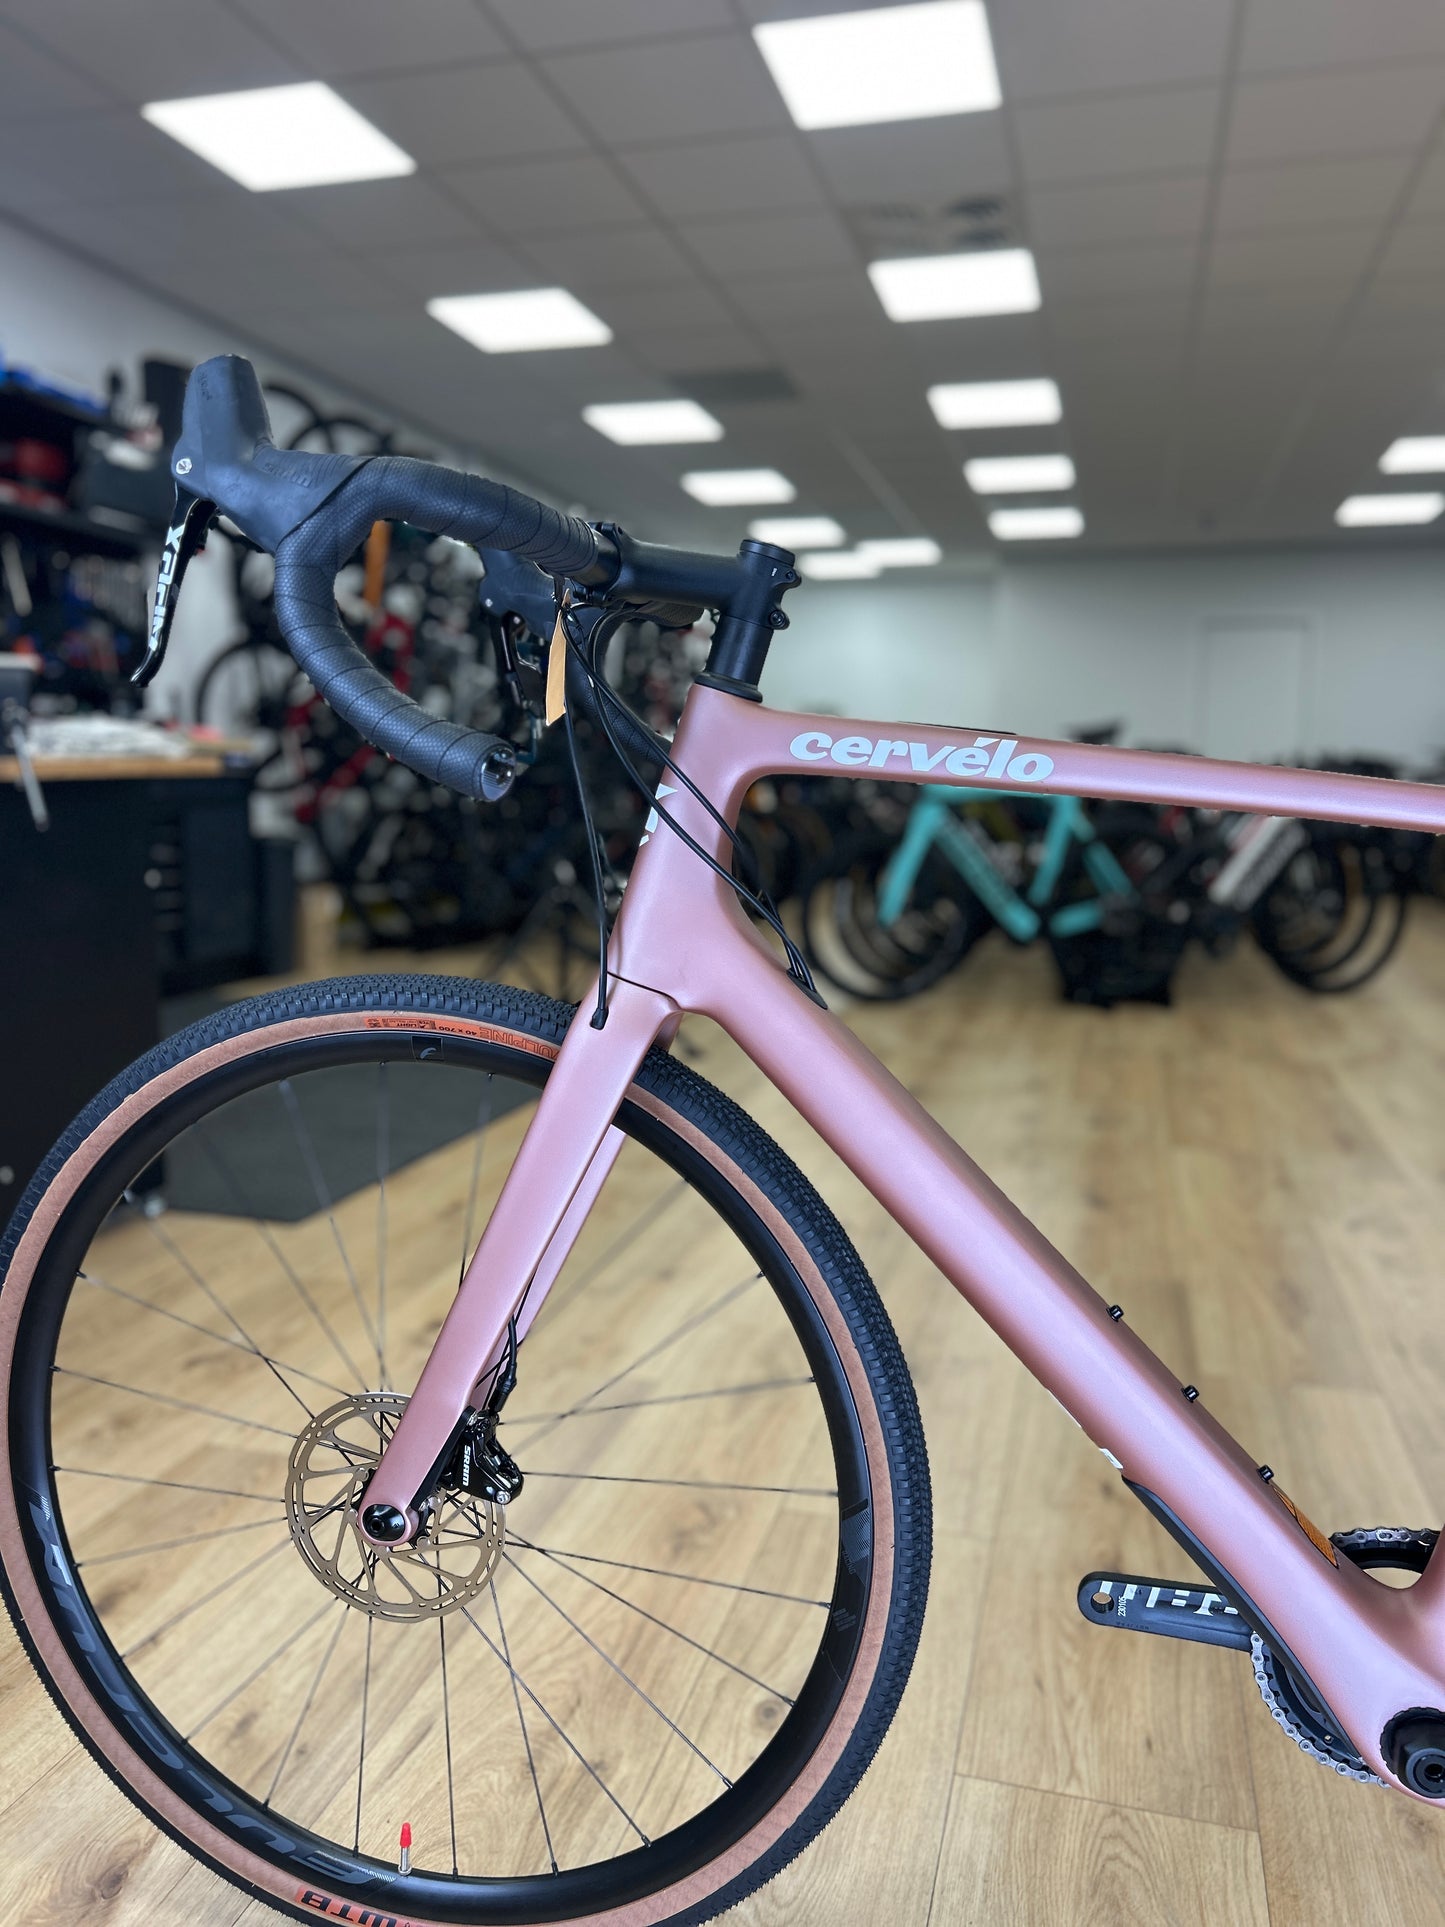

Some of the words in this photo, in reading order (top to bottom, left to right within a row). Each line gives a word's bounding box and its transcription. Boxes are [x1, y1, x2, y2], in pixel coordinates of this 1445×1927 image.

[149, 523, 185, 652] APEX
[789, 731, 1055, 783] cervélo
[438, 1025, 457, 1033] 700
[462, 1444, 471, 1487] SRAM
[301, 1890, 397, 1927] WTB
